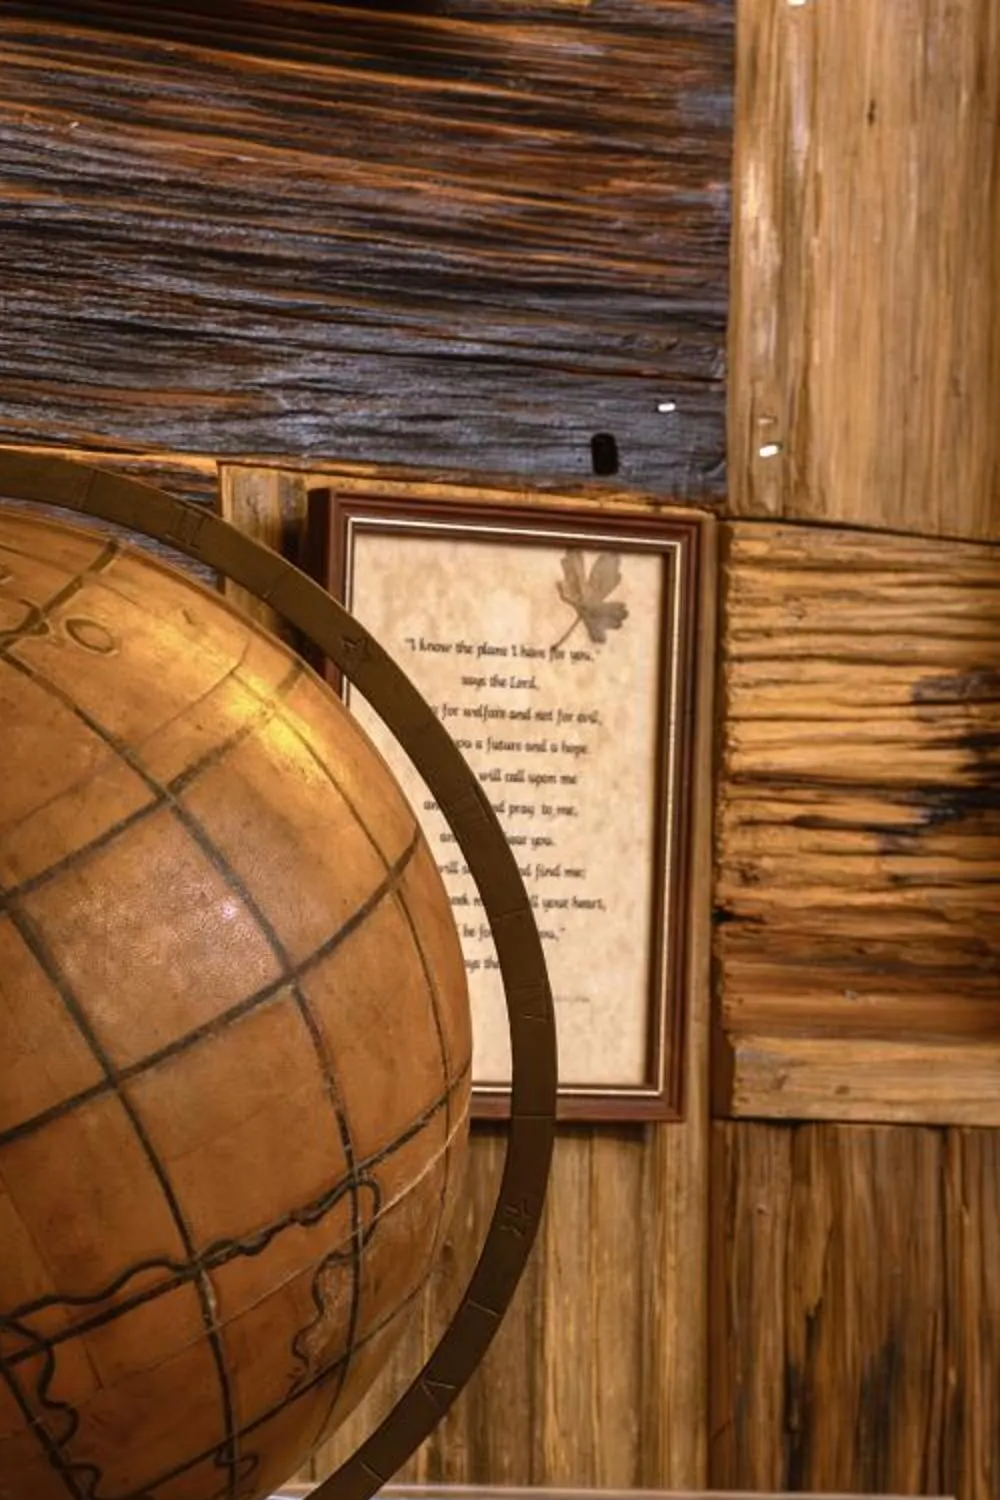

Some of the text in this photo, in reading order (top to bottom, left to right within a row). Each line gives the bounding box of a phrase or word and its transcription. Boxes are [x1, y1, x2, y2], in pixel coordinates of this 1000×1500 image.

[420, 638, 453, 655] know
[455, 639, 473, 655] the
[477, 641, 507, 659] plans
[520, 644, 546, 659] have
[549, 647, 566, 662] for
[489, 674, 507, 689] the
[442, 704, 458, 721] for
[463, 704, 506, 723] welfare
[508, 707, 531, 722] and
[556, 707, 573, 726] for
[486, 737, 522, 755] future
[525, 739, 547, 753] and
[479, 769, 578, 788] will call upon me
[508, 803, 535, 818] pray
[541, 802, 553, 816] to
[535, 864, 561, 882] find
